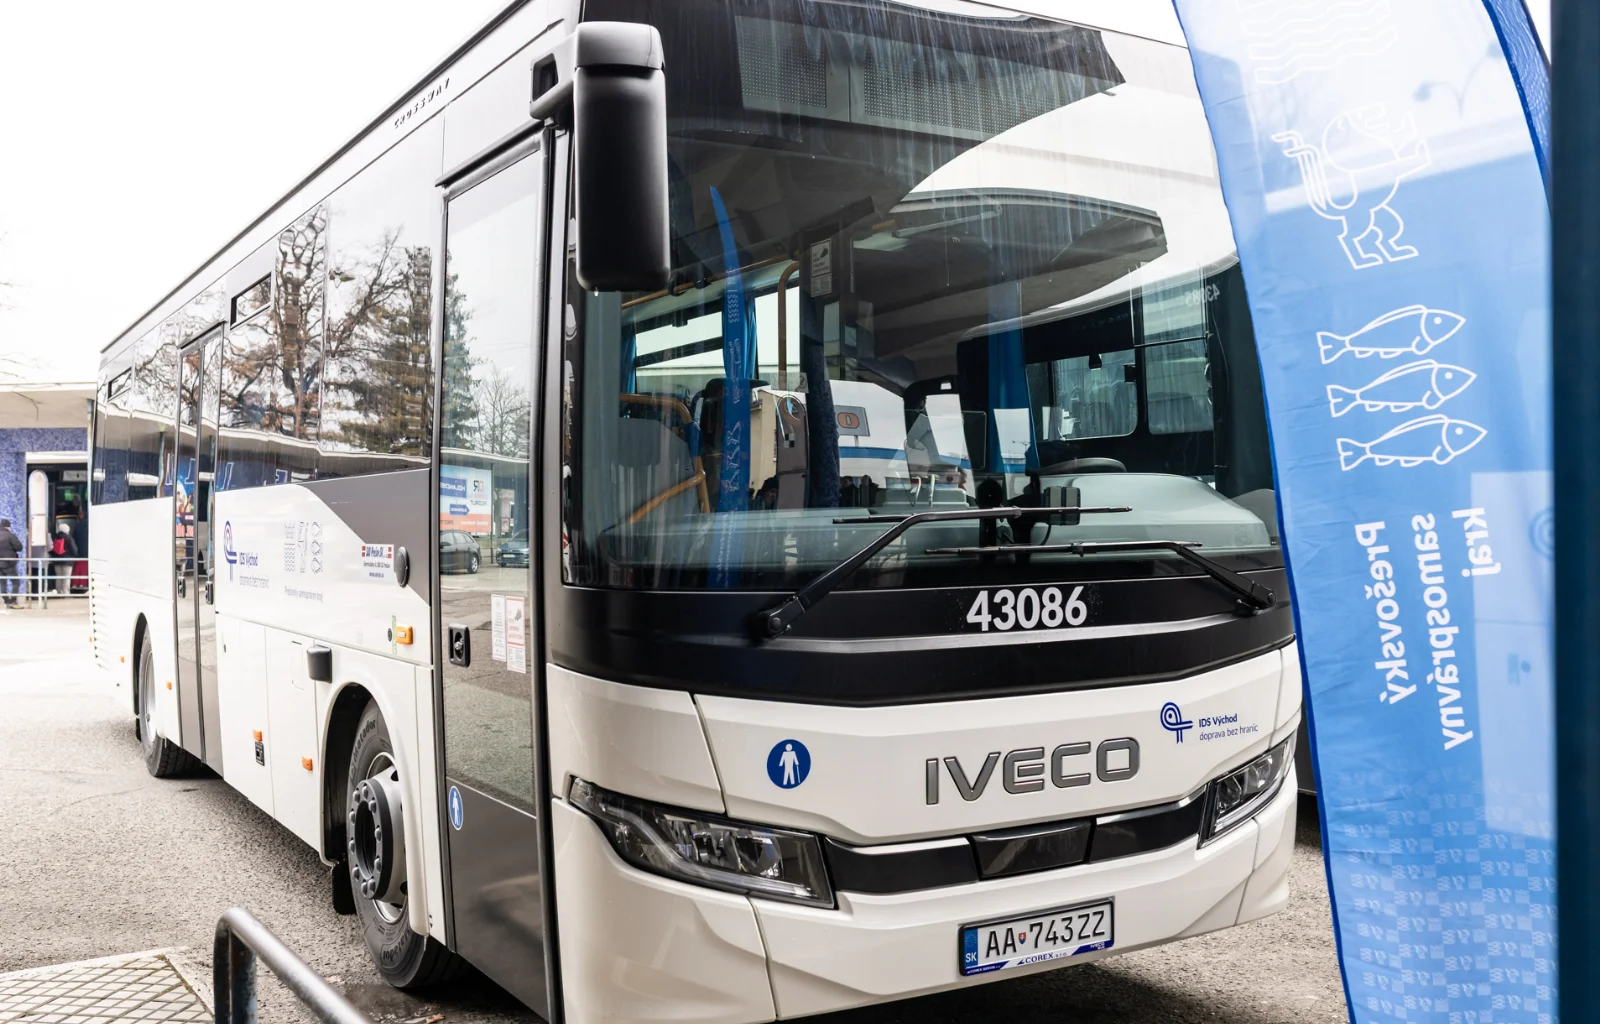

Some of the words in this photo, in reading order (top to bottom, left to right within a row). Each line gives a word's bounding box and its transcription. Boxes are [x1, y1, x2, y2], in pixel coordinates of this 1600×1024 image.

[395, 78, 450, 129] CROSSWAY
[966, 586, 1087, 631] 43086
[1199, 717, 1211, 728] IDS
[1212, 713, 1238, 727] Východ
[1200, 731, 1226, 741] doprava
[1227, 727, 1239, 737] bez
[1240, 723, 1258, 734] hranic
[354, 720, 376, 763] Matador
[926, 737, 1140, 805] IVECO
[965, 951, 978, 963] SK
[986, 927, 1017, 958] AA
[1025, 952, 1054, 963] COREX
